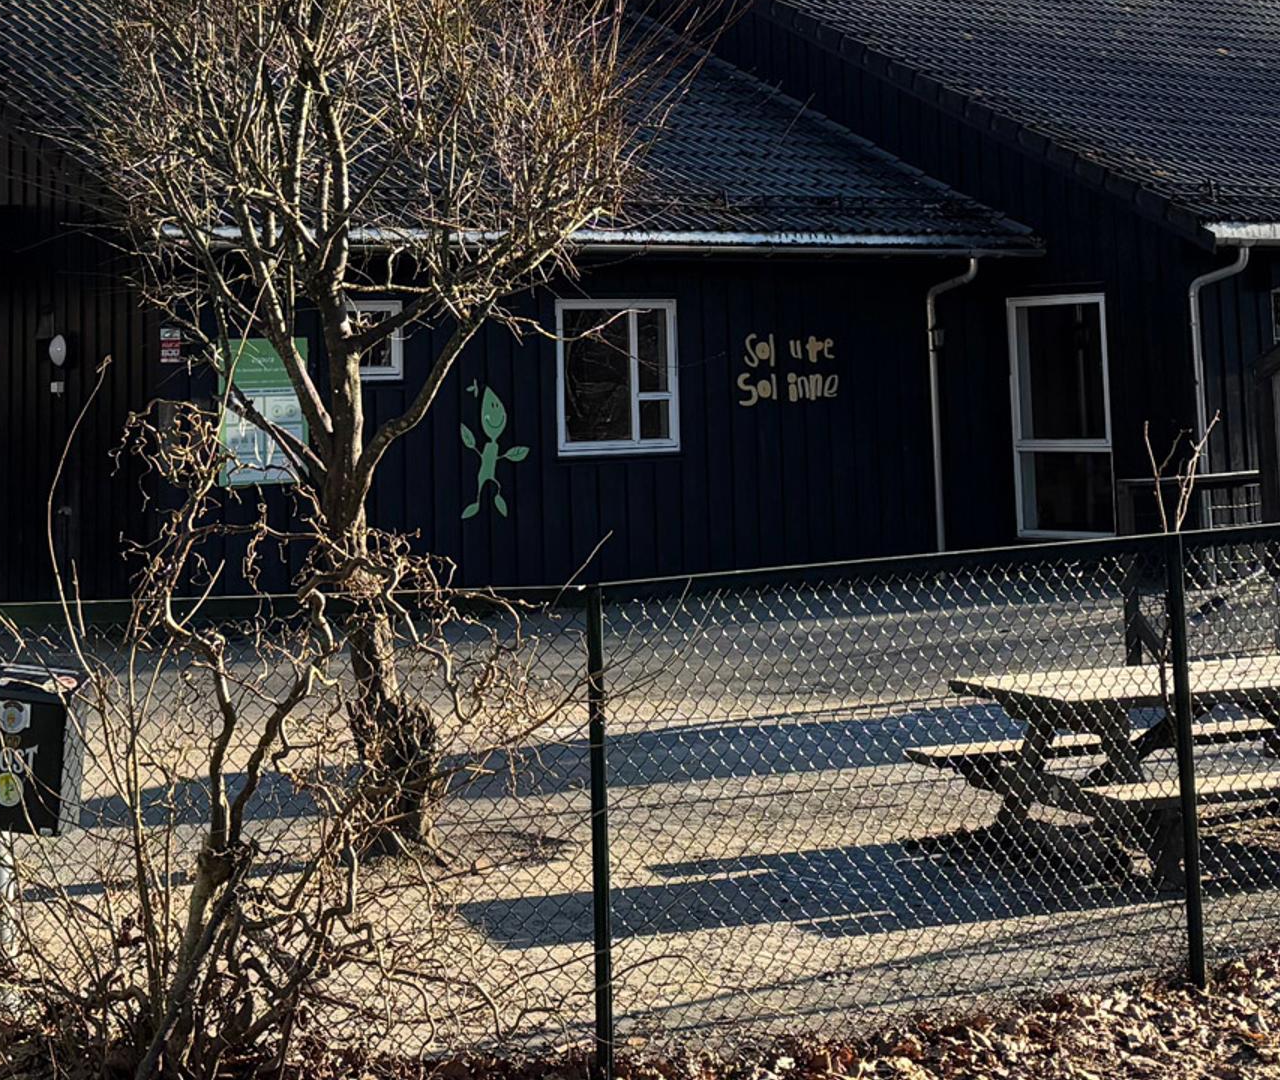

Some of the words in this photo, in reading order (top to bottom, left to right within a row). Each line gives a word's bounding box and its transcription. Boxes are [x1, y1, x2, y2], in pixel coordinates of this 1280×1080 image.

[744, 333, 775, 367] Sol
[789, 335, 835, 363] ute
[737, 373, 777, 406] Sol
[787, 373, 839, 402] inne
